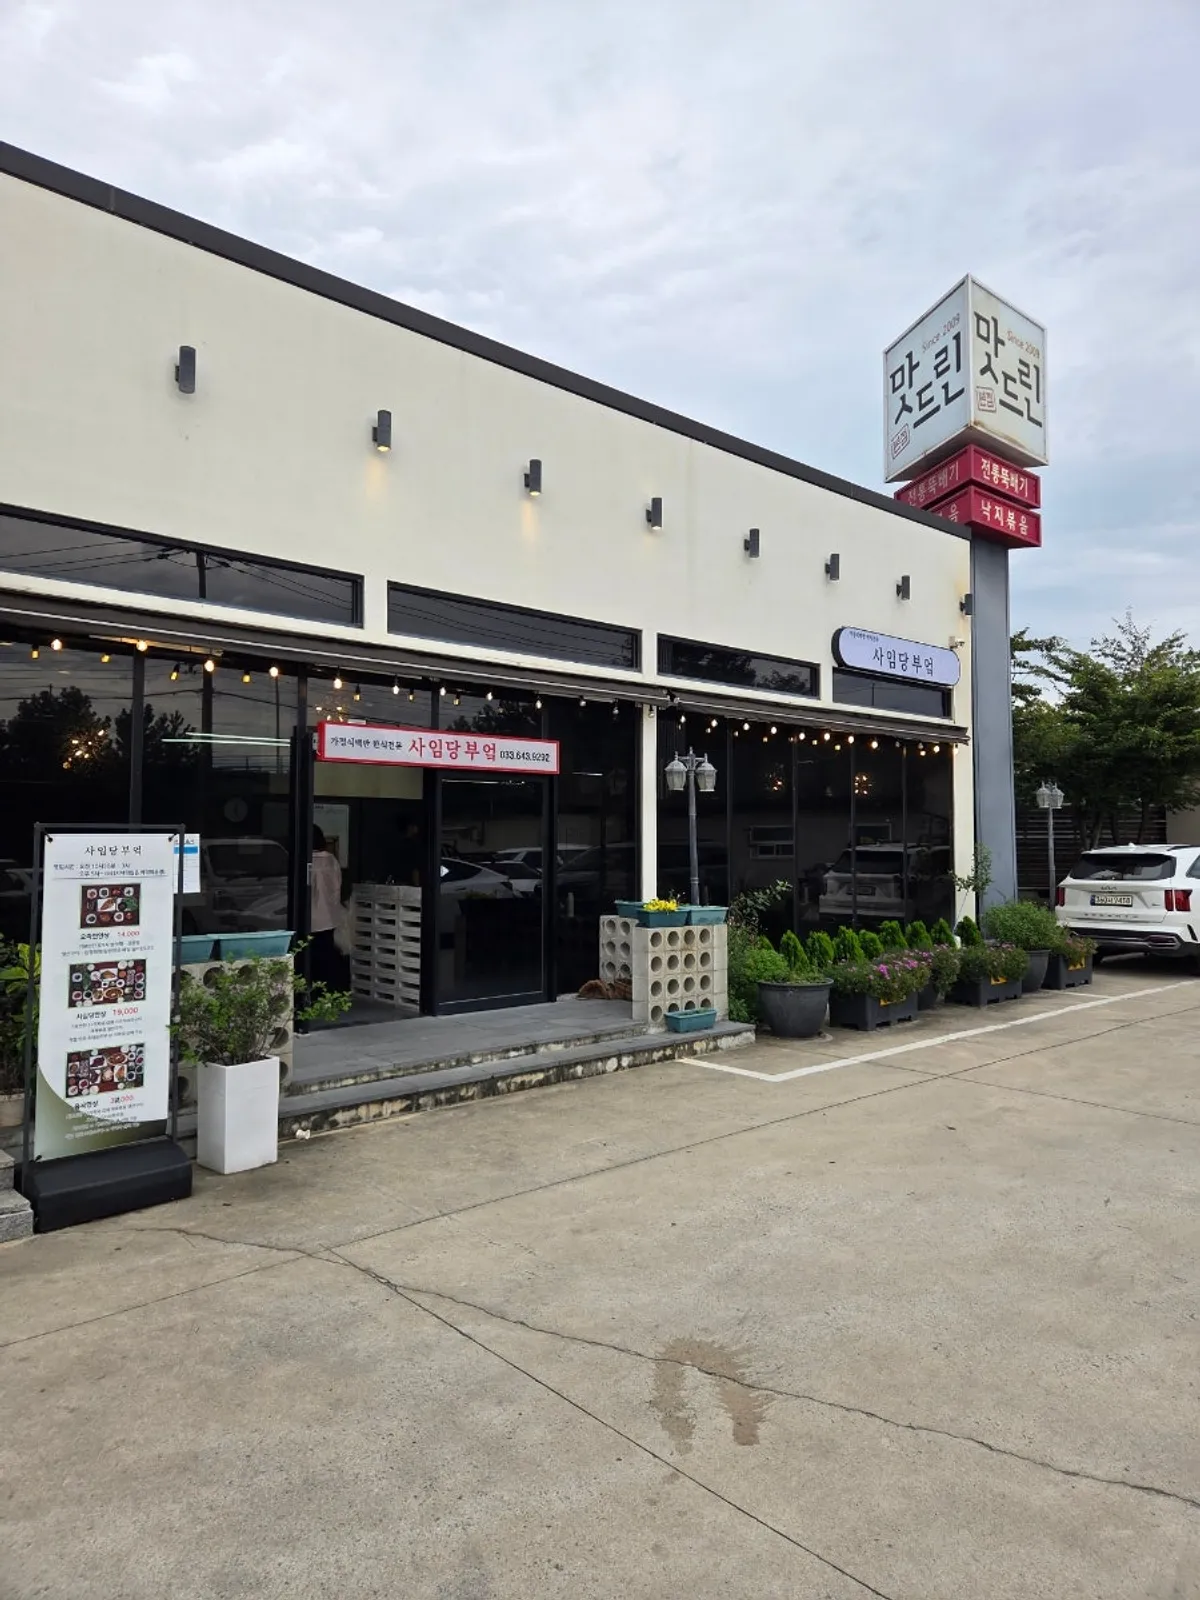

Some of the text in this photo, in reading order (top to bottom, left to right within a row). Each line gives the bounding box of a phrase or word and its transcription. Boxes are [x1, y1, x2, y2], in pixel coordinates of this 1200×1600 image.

[981, 457, 1029, 498] 전통뚝배기
[981, 499, 1029, 536] 낙지볶음
[873, 646, 934, 677] 사임당부엌
[408, 737, 497, 762] 사임당부엌
